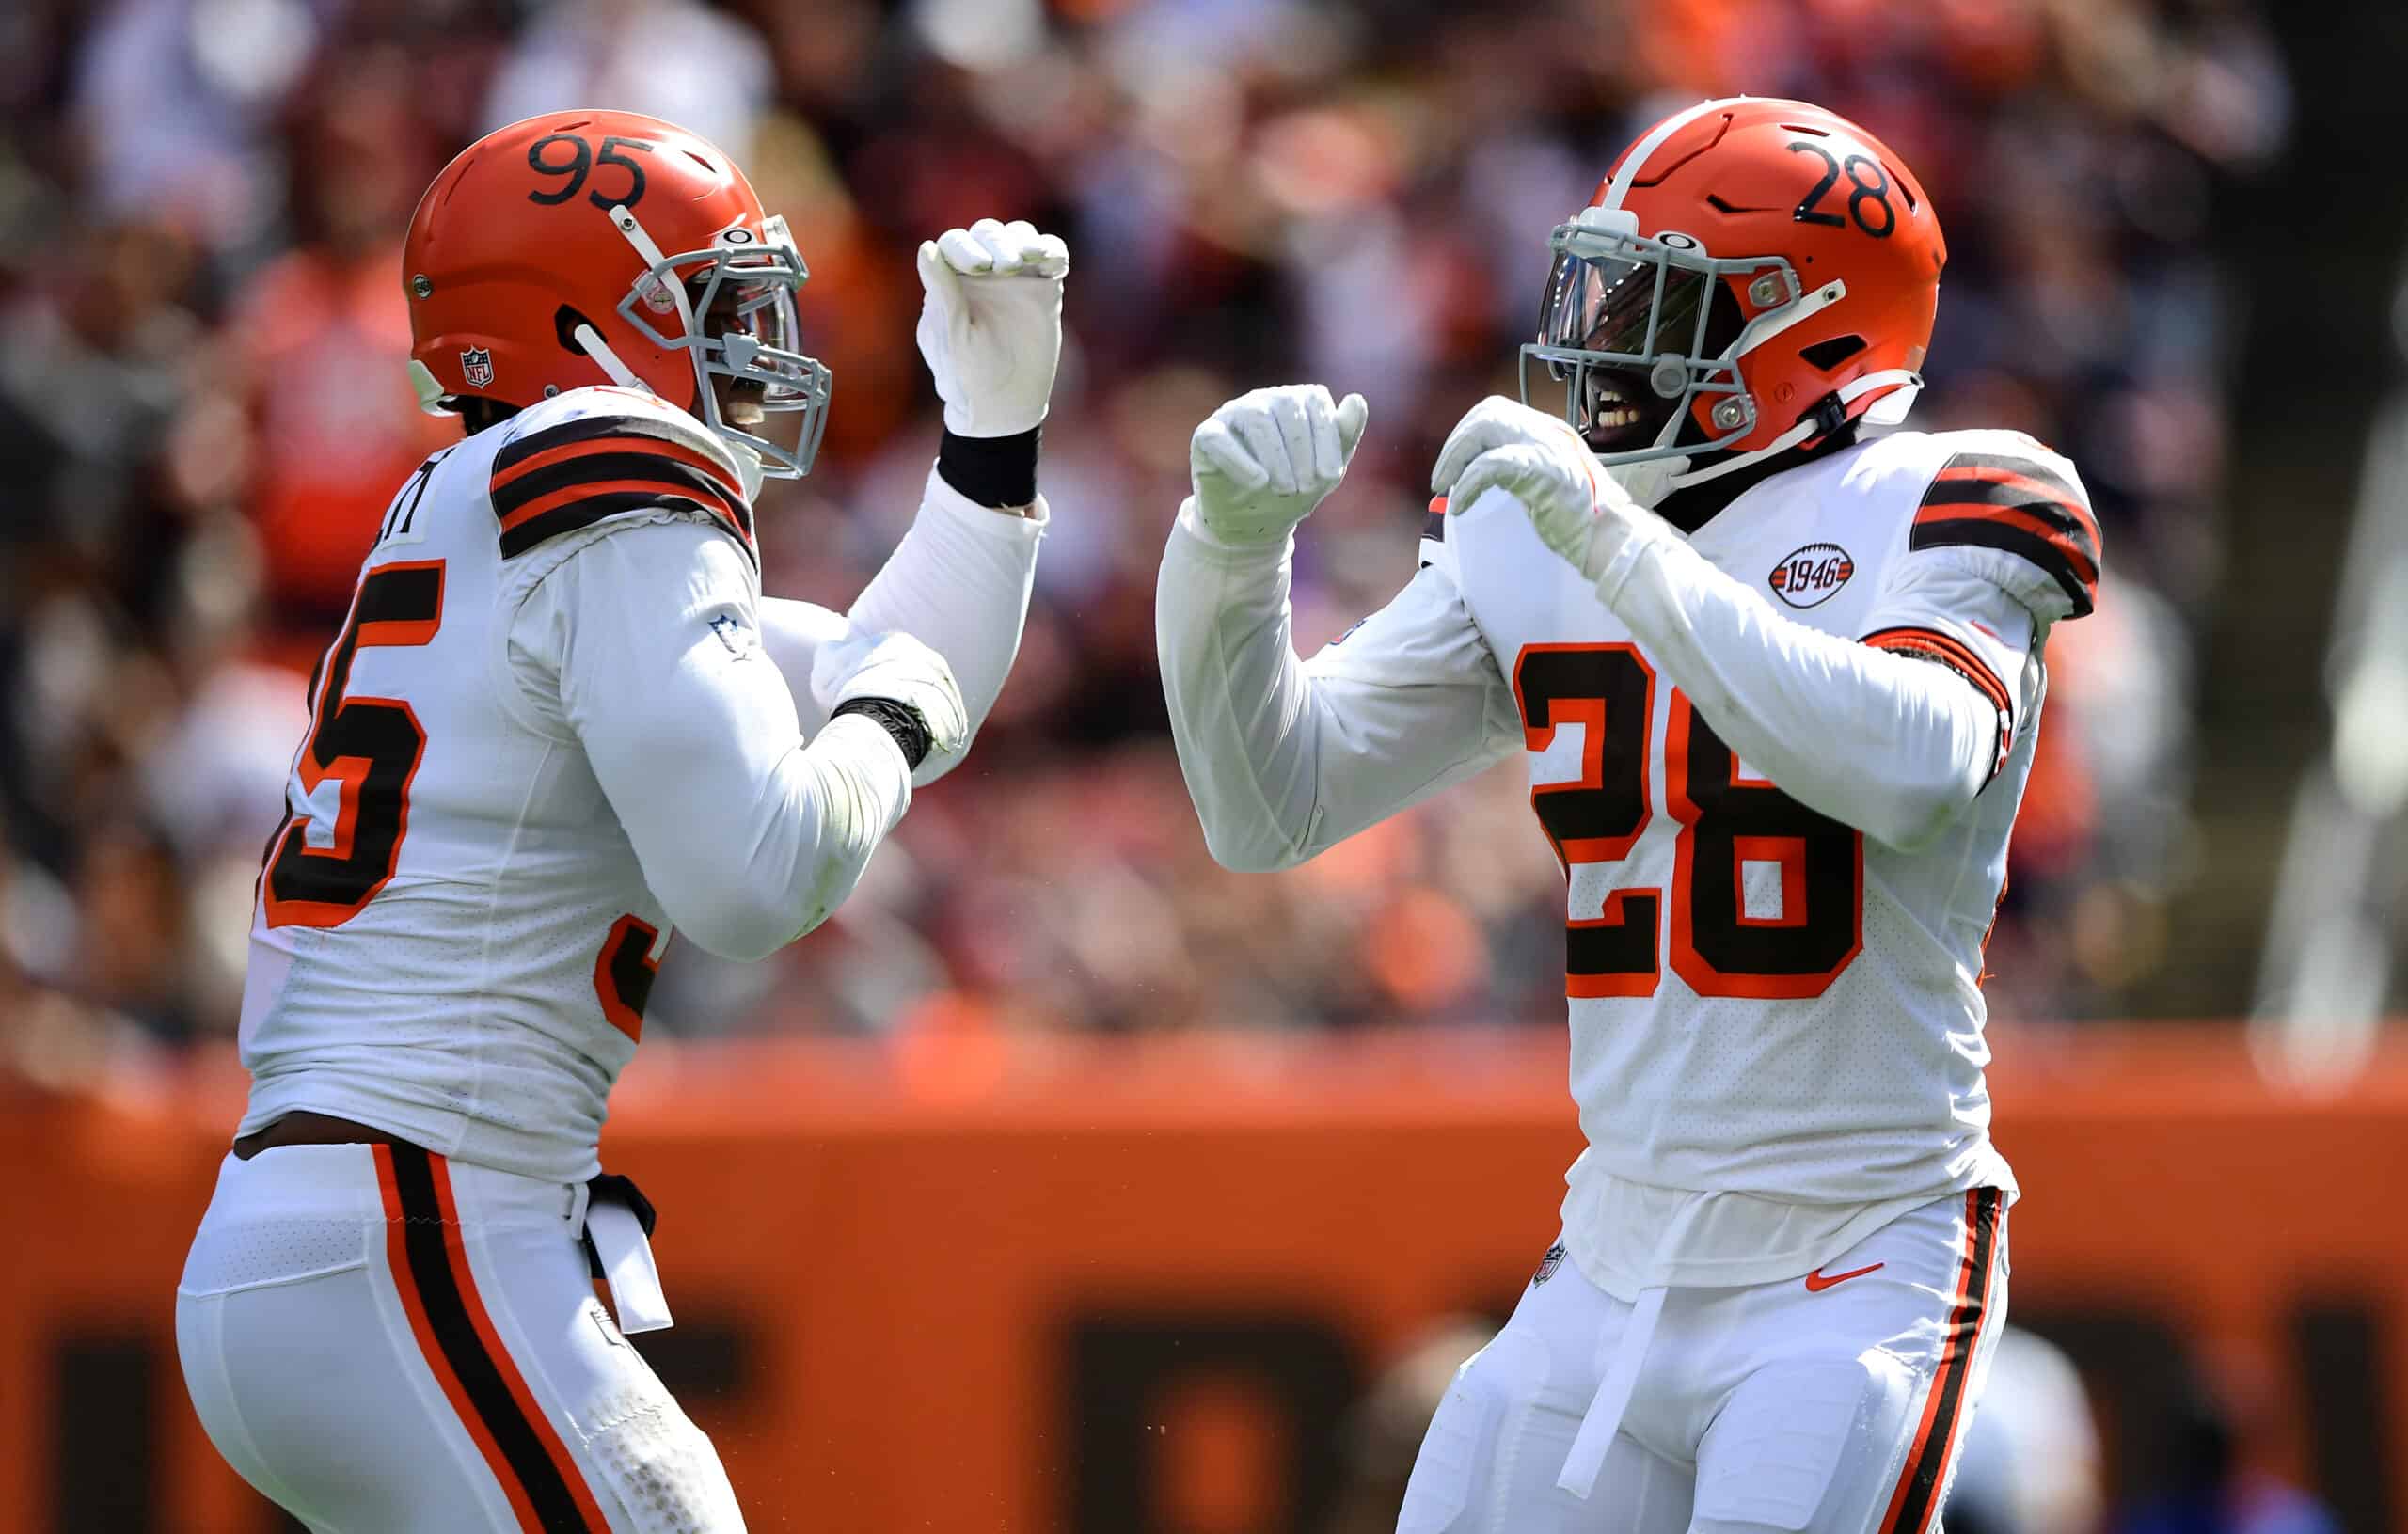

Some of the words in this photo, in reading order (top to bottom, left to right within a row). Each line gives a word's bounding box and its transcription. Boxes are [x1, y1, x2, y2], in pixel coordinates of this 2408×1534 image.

[527, 134, 654, 211] 95
[1786, 141, 1895, 239] 28
[1785, 557, 1840, 593] 1946
[1513, 641, 1864, 1000] 28
